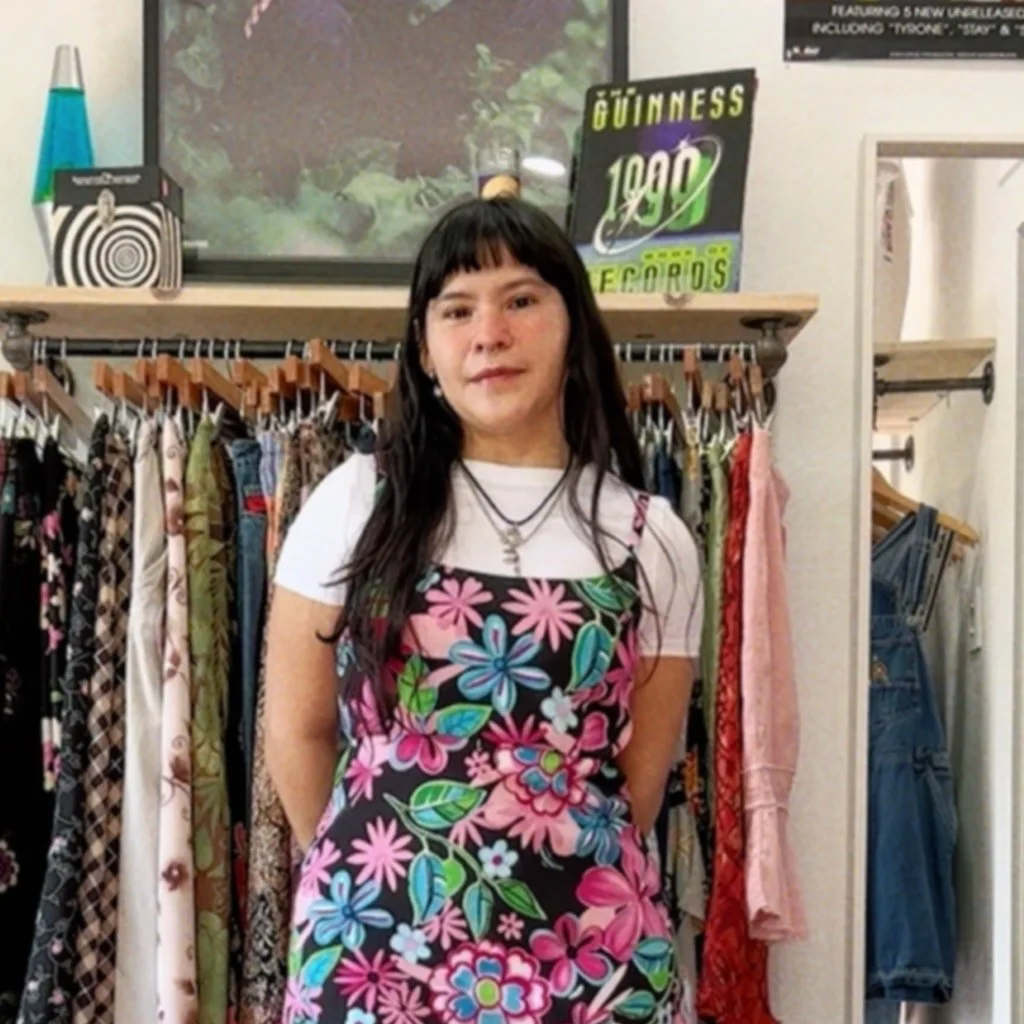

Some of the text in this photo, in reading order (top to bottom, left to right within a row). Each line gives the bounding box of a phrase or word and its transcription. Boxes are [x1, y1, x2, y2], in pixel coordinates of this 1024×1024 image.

[831, 5, 1024, 19] FEATURING 5 NEW UNRELEASED
[812, 21, 884, 35] INCLUDING
[1000, 25, 1010, 36] &
[592, 84, 744, 131] GUINNESS
[600, 257, 727, 293] ECORDS
